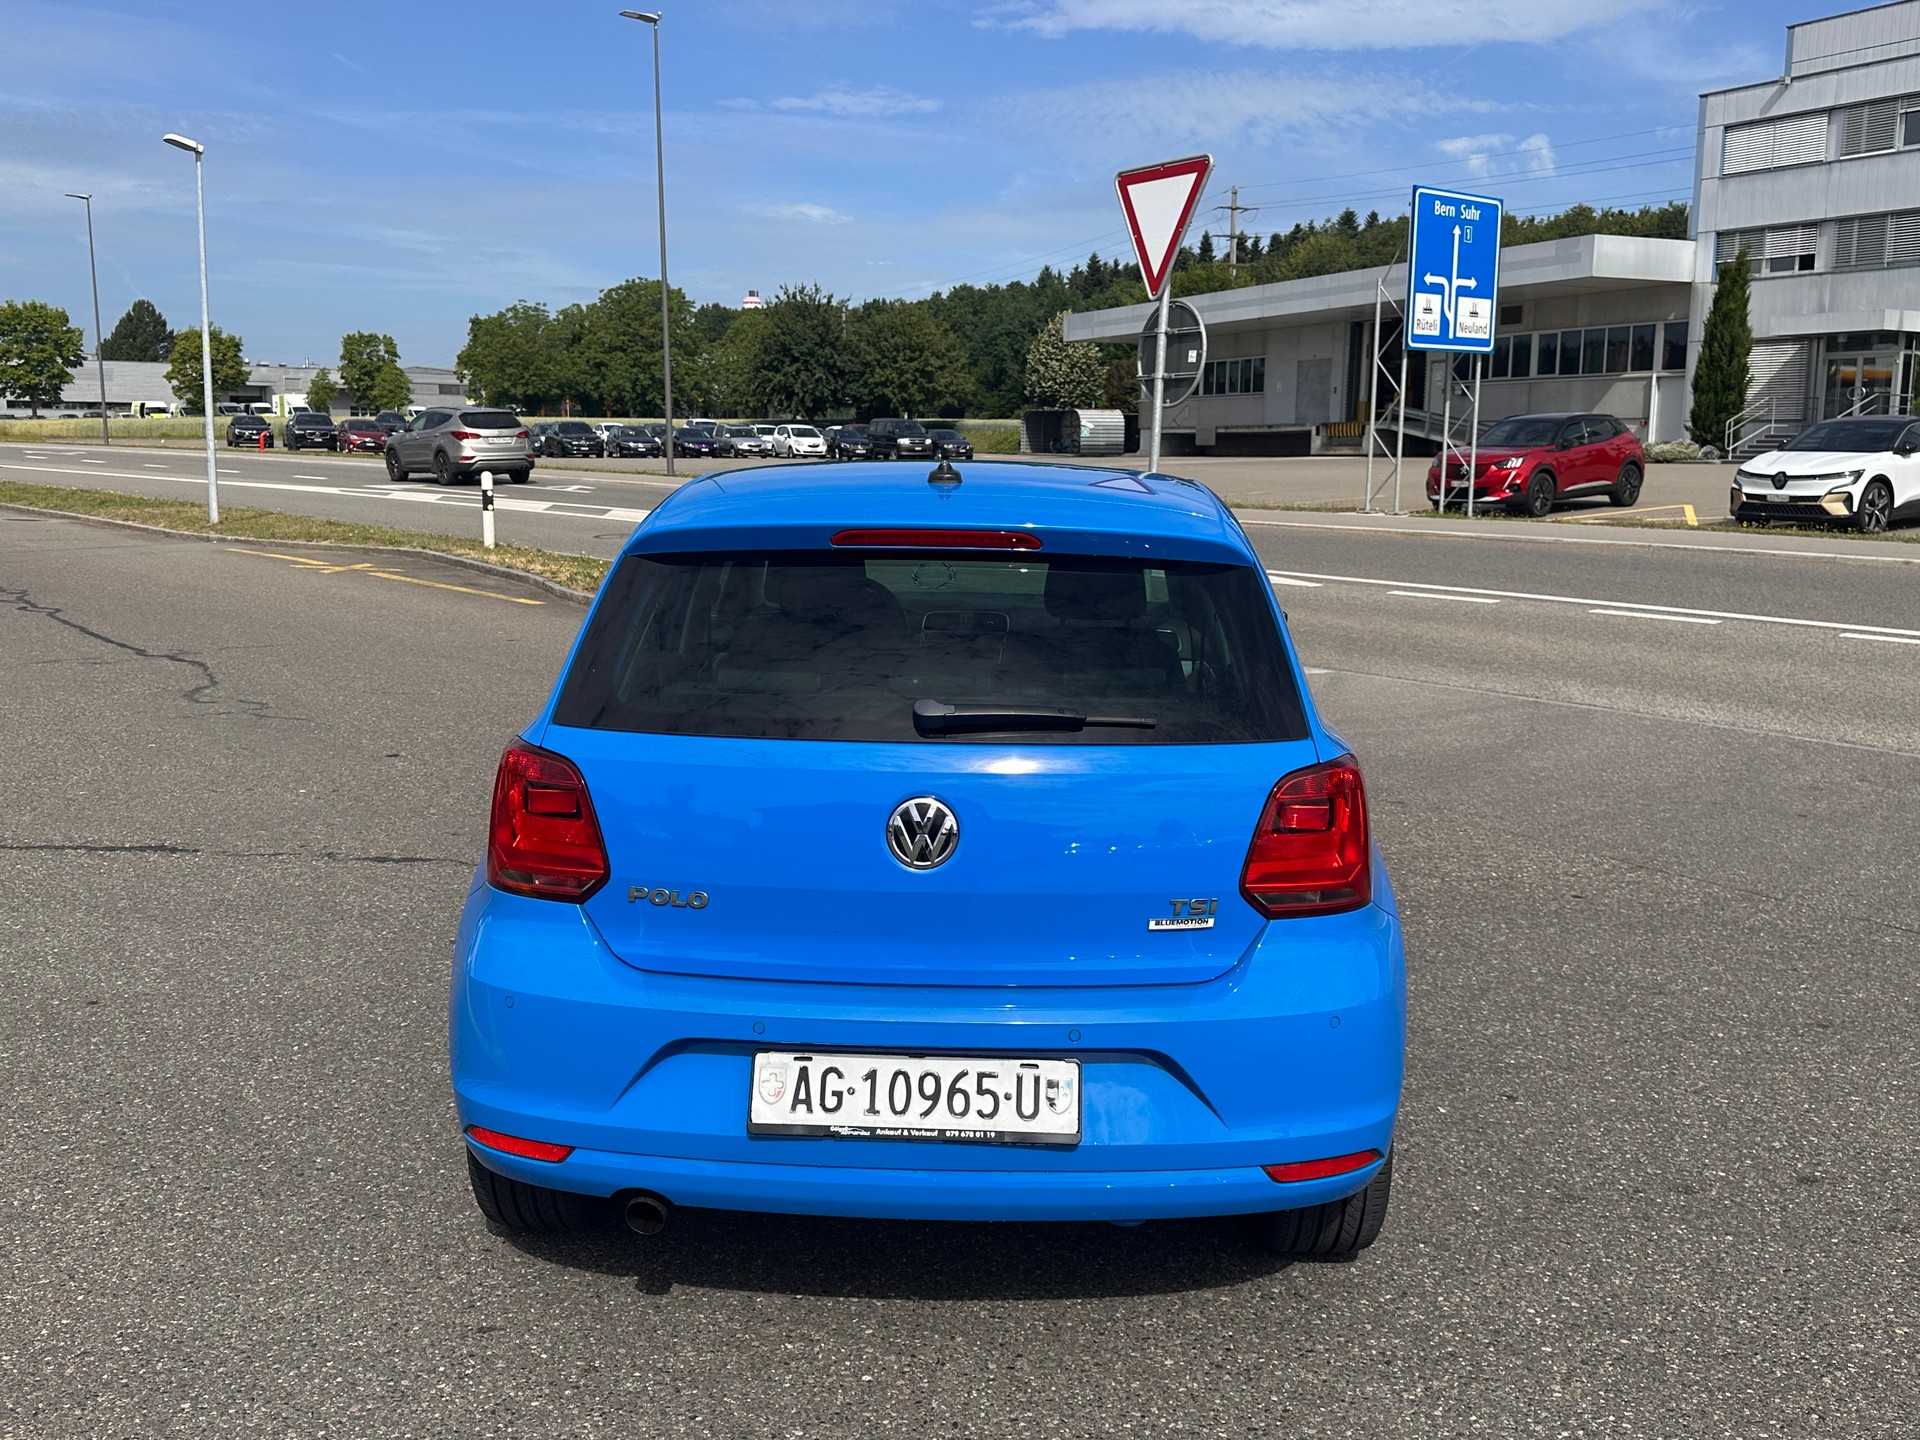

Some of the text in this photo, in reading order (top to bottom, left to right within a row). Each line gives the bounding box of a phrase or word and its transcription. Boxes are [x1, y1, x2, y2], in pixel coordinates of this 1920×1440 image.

[1434, 200, 1481, 221] Bern Suhr
[1416, 318, 1438, 332] Rüteli
[1458, 322, 1488, 335] Neuland
[628, 886, 709, 909] POLO
[1170, 898, 1218, 916] TSI
[1154, 918, 1209, 926] BLUEMOTION
[875, 1128, 901, 1136] Ankauf
[910, 1129, 938, 1137] Verkauf
[960, 1130, 974, 1138] 678
